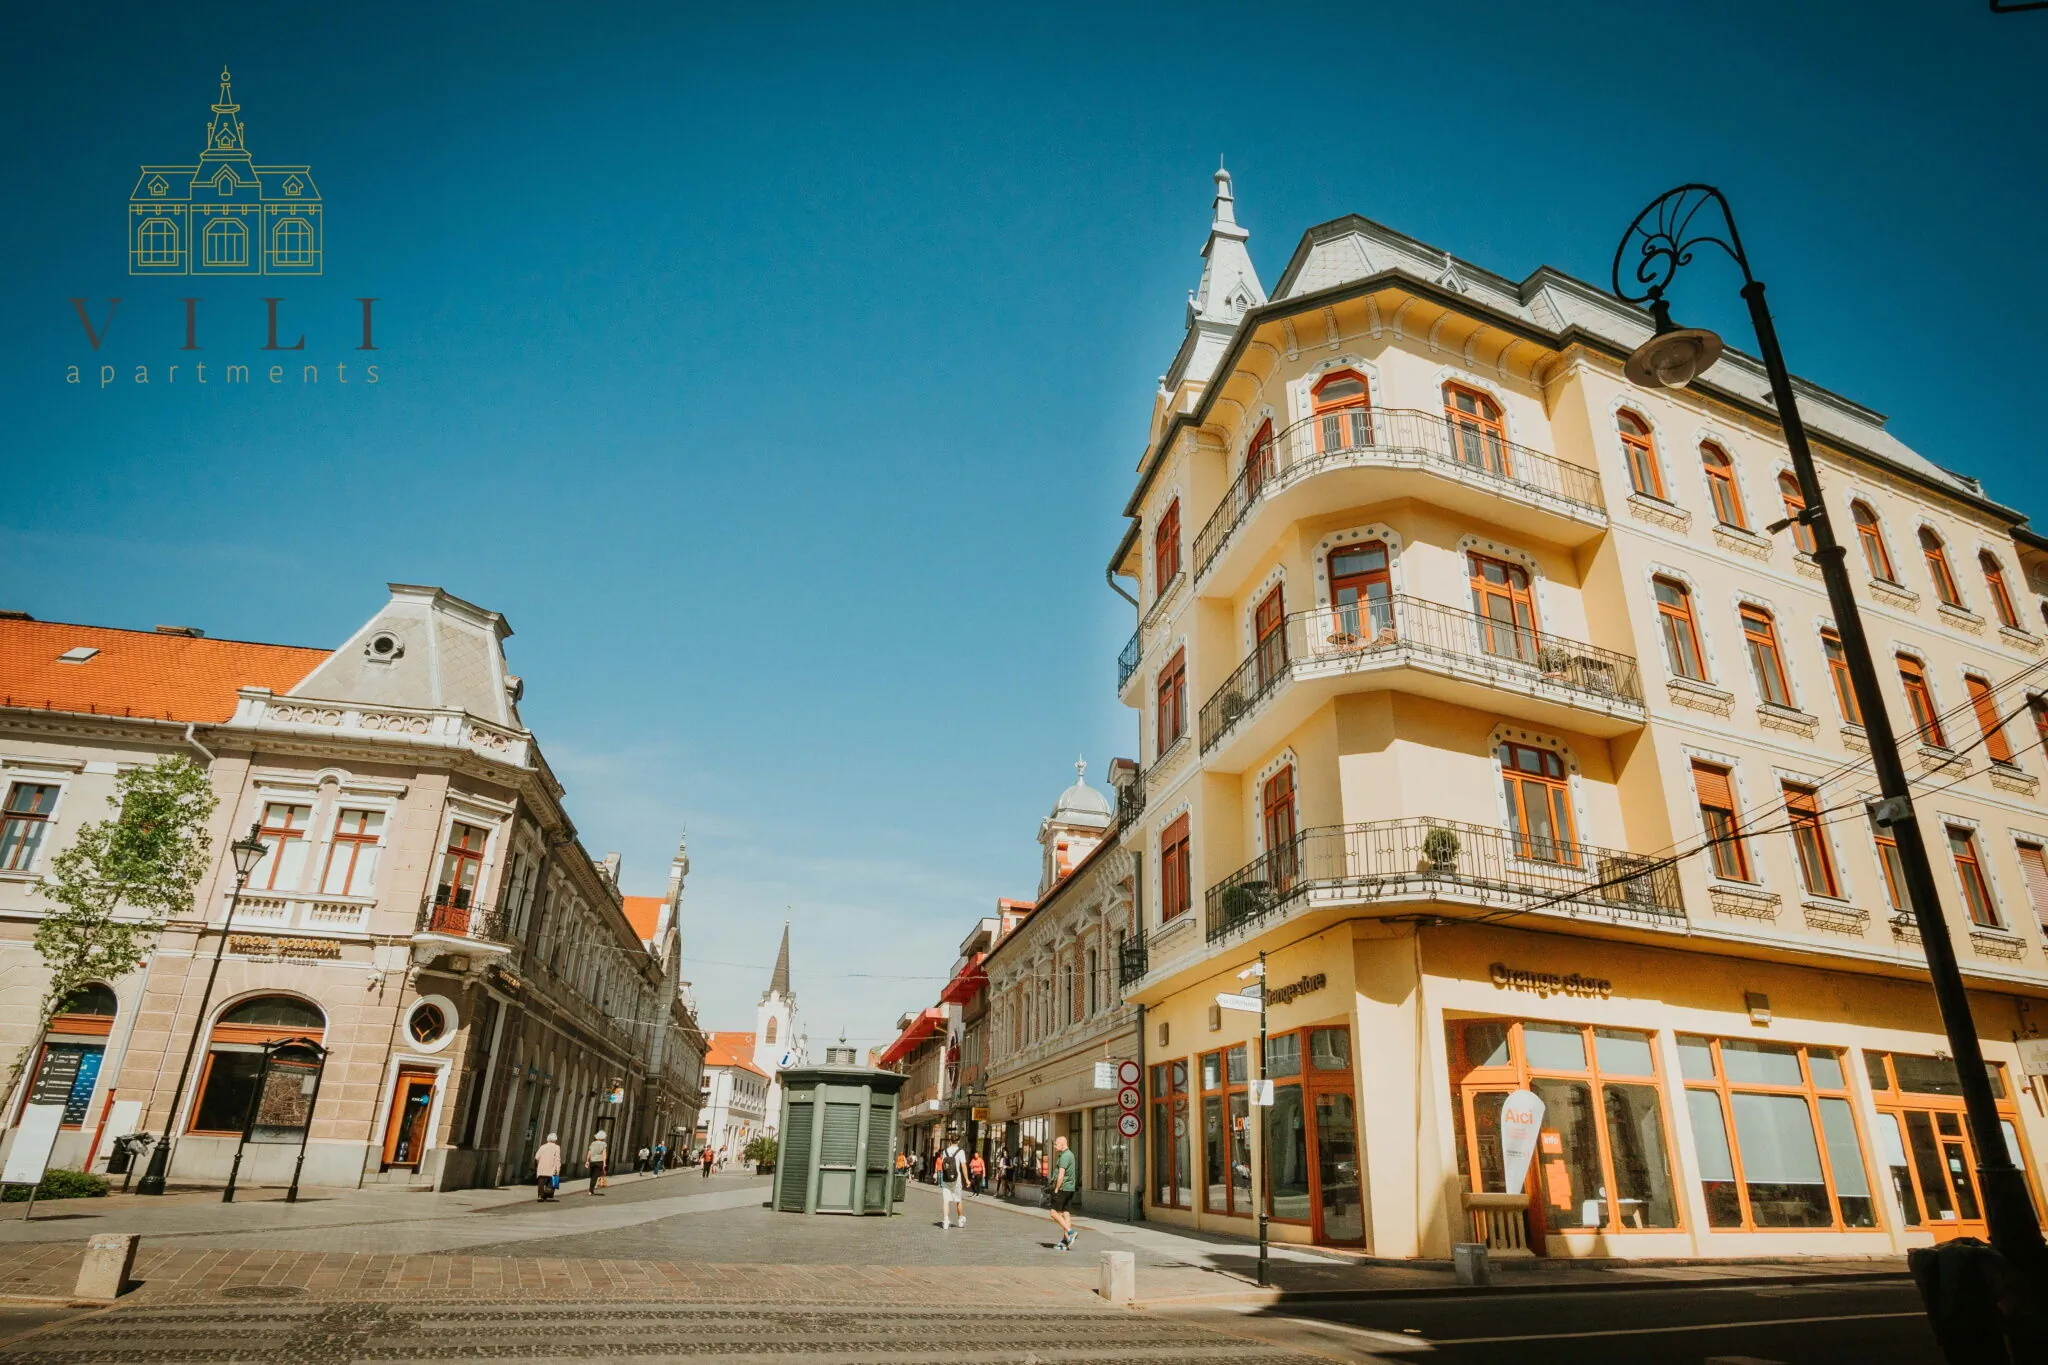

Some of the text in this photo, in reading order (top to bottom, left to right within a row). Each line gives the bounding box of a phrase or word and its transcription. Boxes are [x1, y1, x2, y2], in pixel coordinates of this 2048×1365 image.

[1266, 984, 1297, 1005] range
[1297, 973, 1326, 995] store
[1488, 962, 1612, 996] Orange store
[1505, 1108, 1534, 1125] Aici
